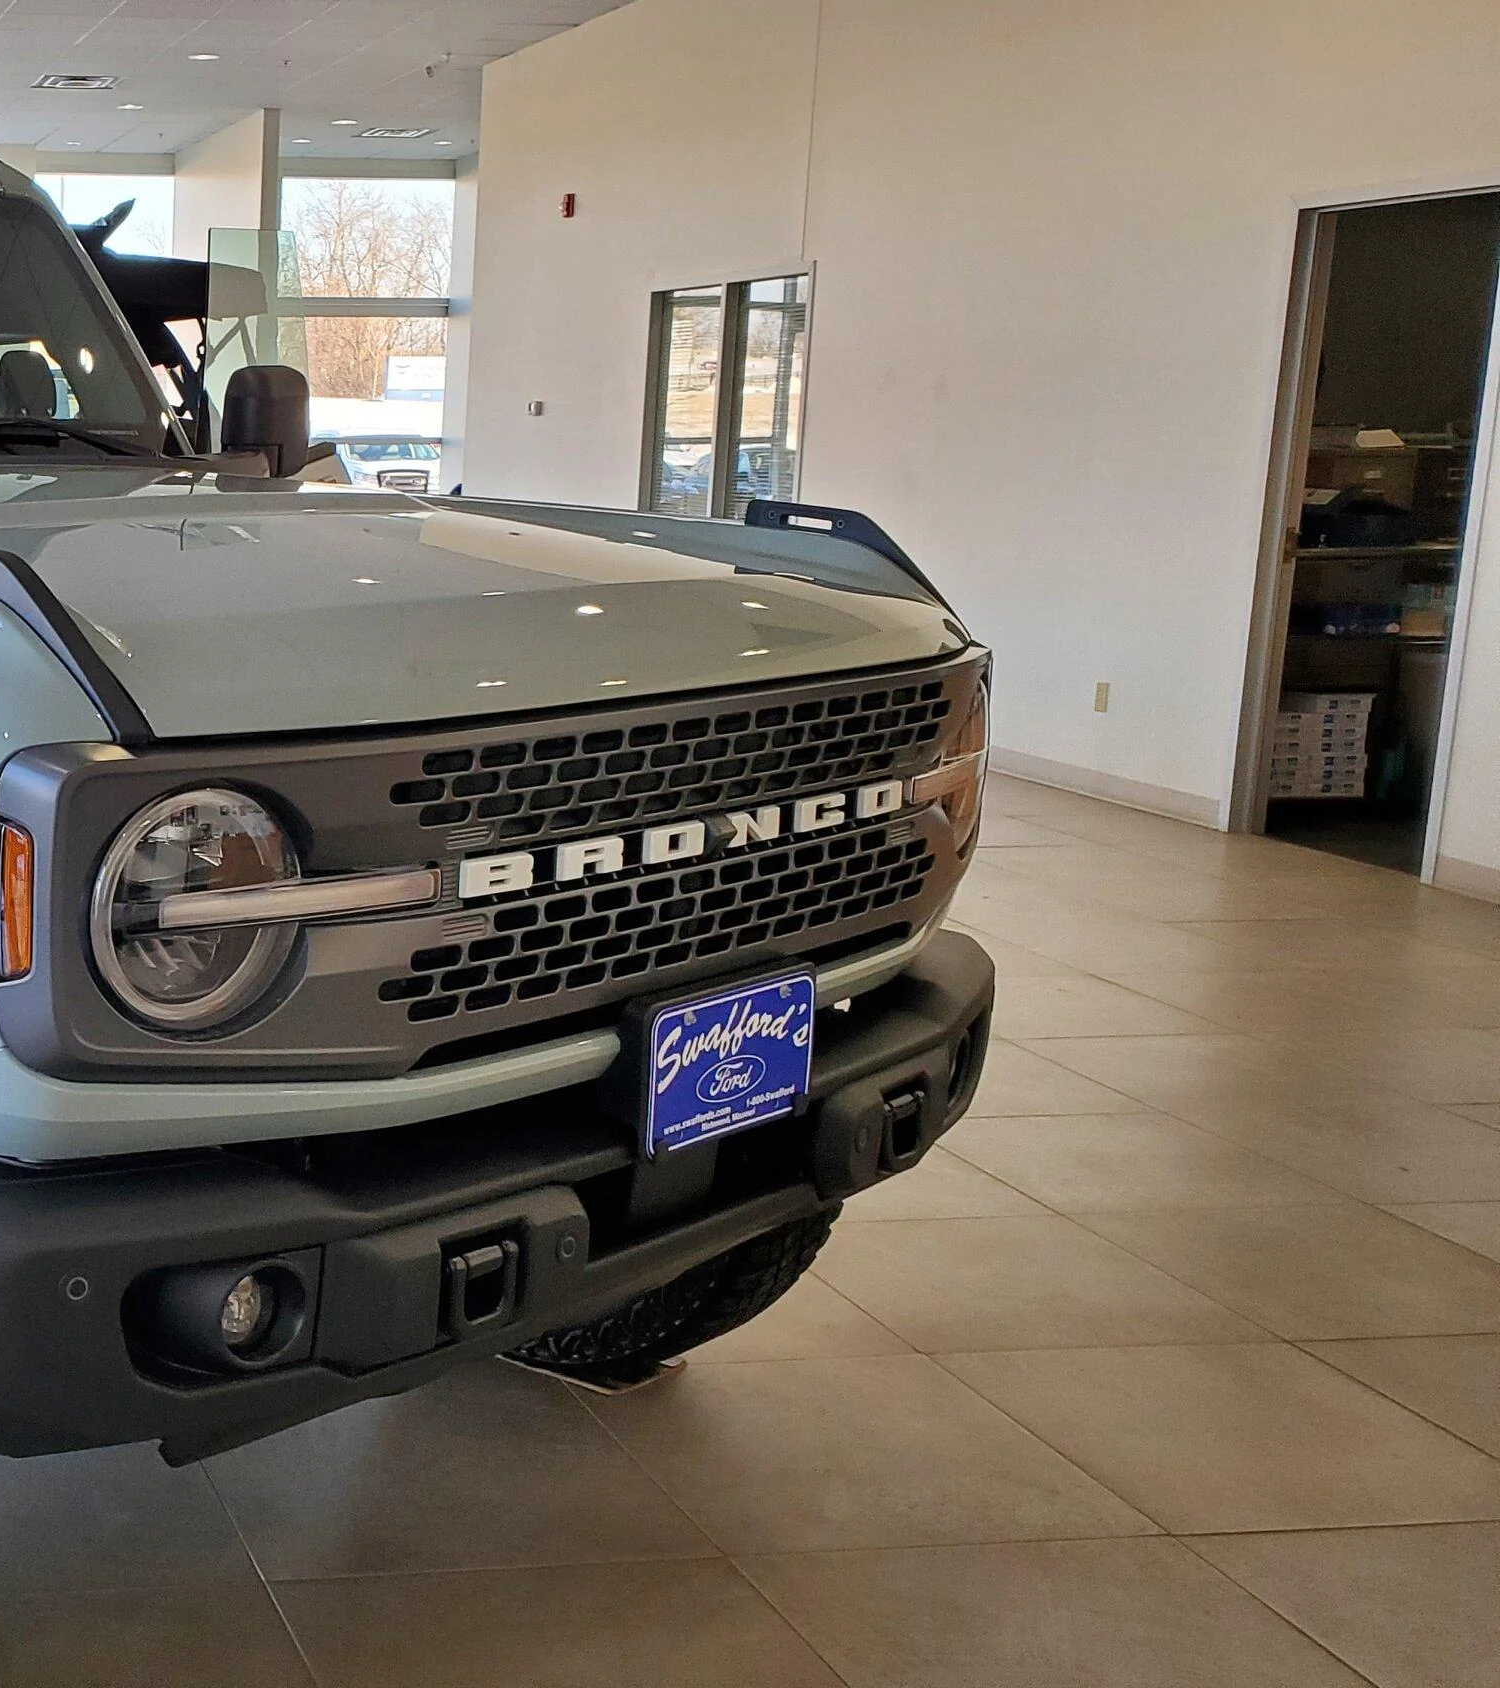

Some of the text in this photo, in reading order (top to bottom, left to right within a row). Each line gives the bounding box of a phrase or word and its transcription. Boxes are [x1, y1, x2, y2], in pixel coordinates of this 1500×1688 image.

[459, 780, 903, 898] BRONCO
[657, 998, 810, 1094] Swafford's
[709, 1061, 753, 1097] Ford
